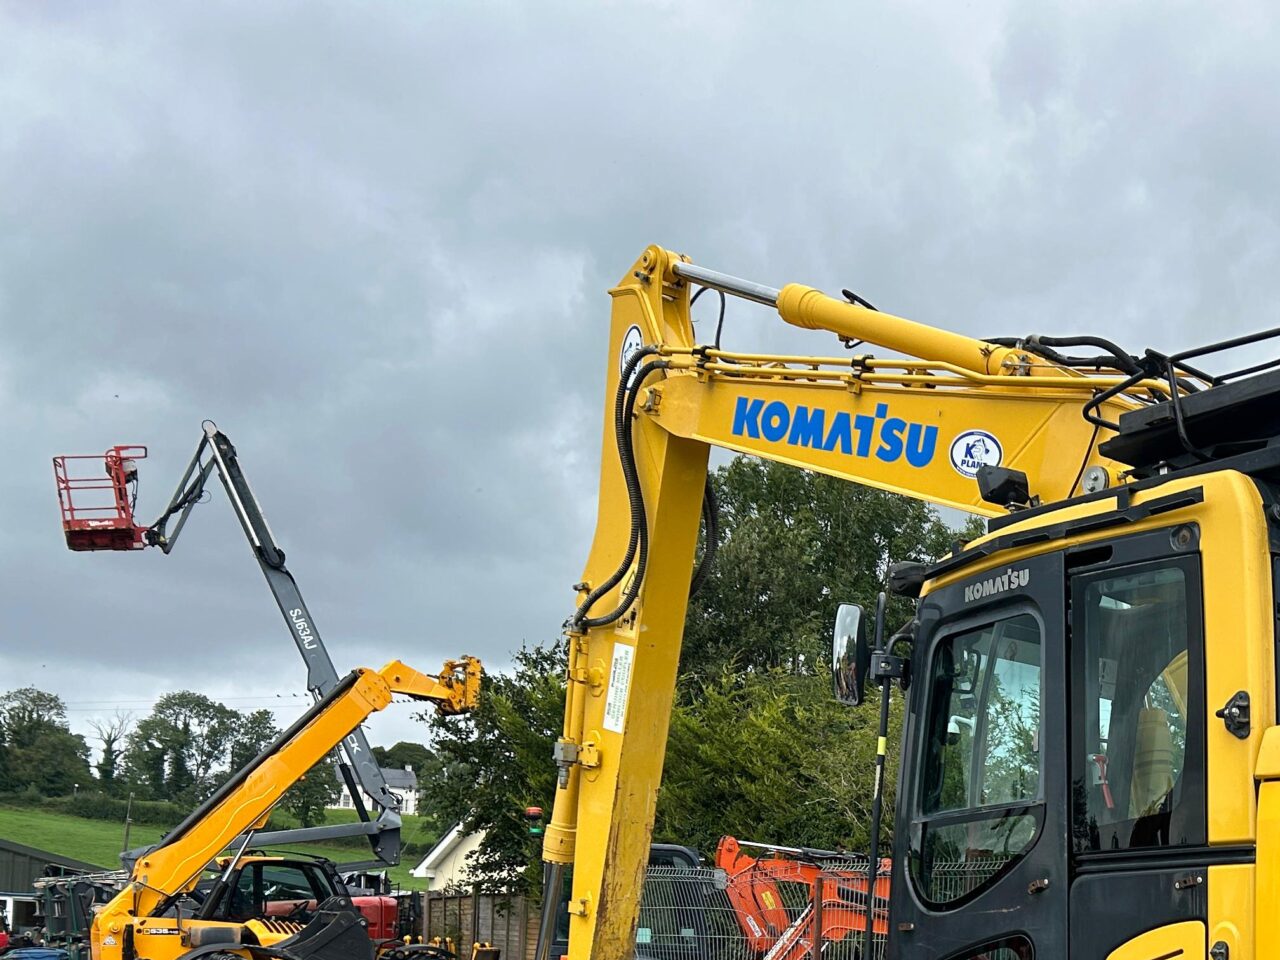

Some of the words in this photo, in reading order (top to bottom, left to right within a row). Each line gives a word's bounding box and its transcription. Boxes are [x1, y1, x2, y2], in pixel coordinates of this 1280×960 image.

[732, 396, 939, 468] KOMATSU
[964, 568, 1030, 603] KOMATSU
[289, 608, 318, 650] SJ63AJ
